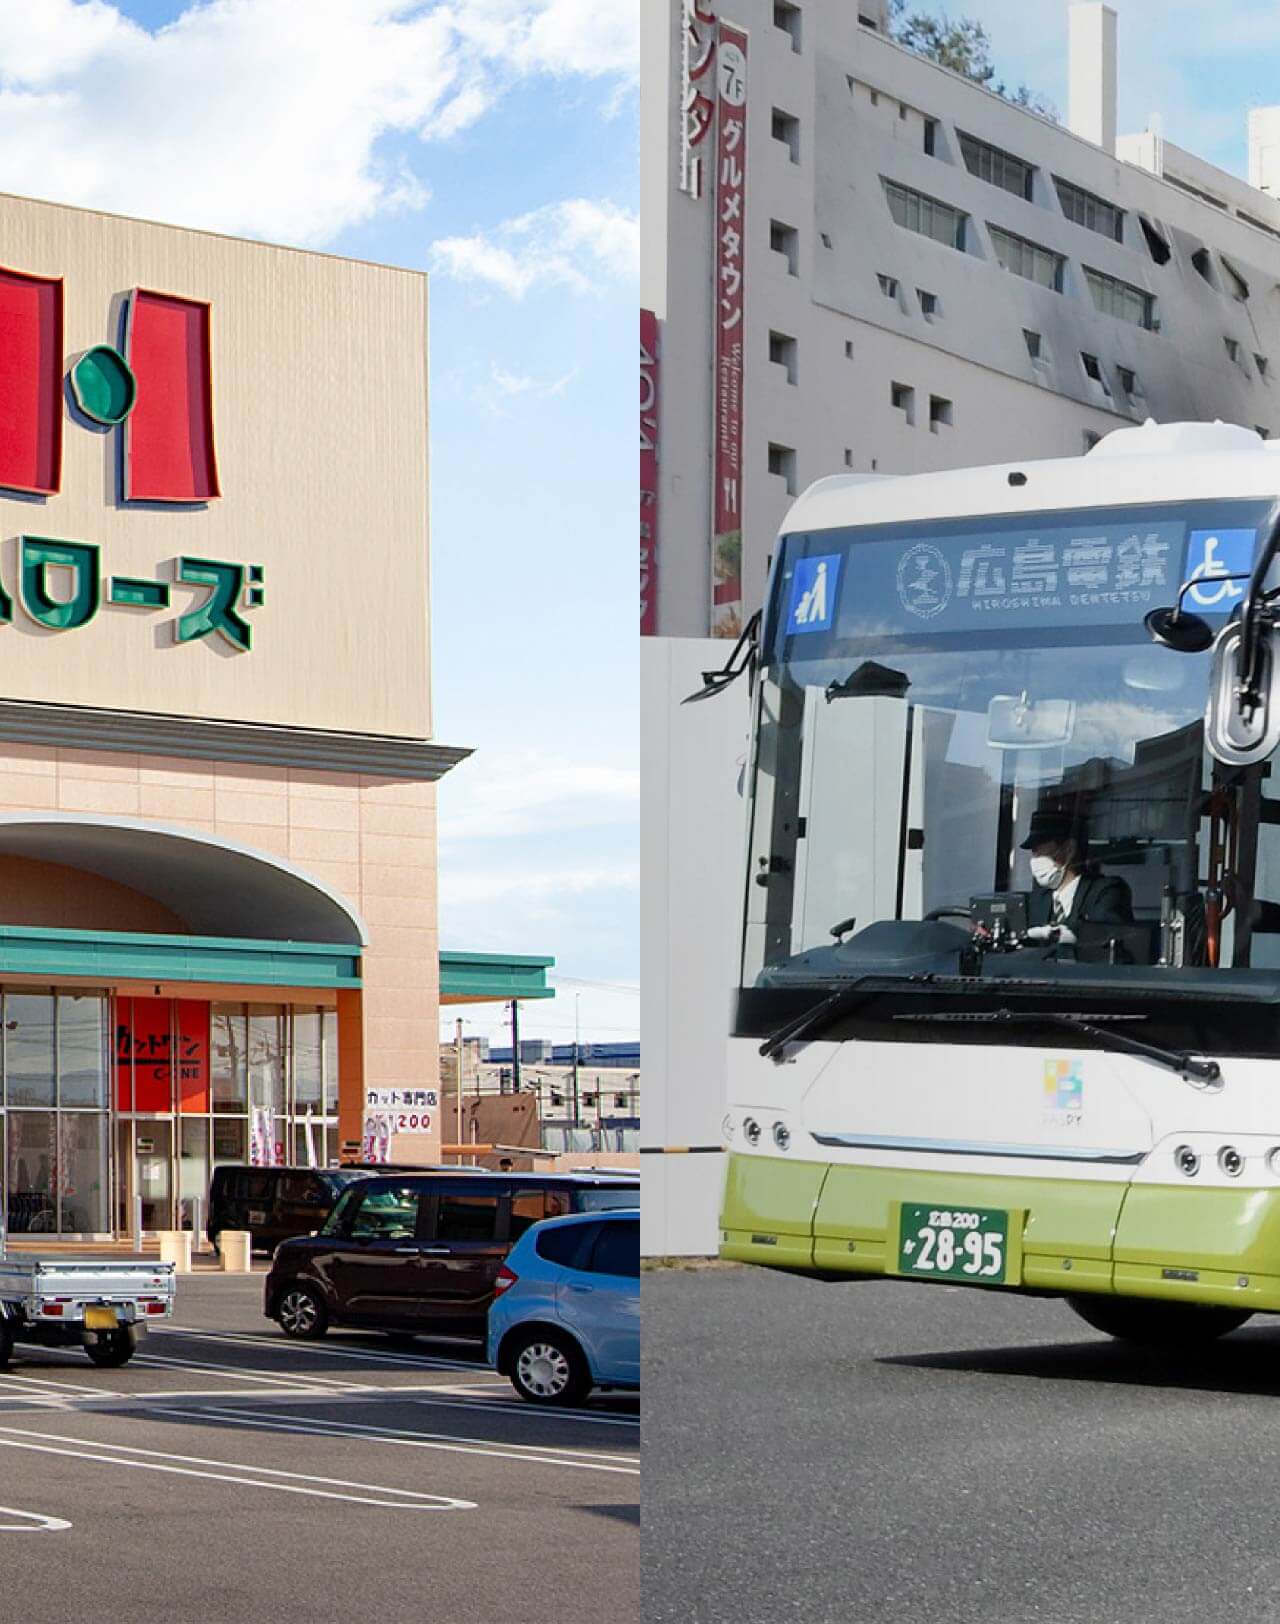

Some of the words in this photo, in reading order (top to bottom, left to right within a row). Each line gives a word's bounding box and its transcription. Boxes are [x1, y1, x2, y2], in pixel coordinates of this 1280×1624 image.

[722, 64, 744, 99] 7F
[721, 118, 742, 330] グルメタウン
[730, 343, 741, 413] Welcome
[730, 442, 739, 470] our
[956, 533, 1170, 598] 広島電鉄
[912, 1227, 1004, 1276] 28-95
